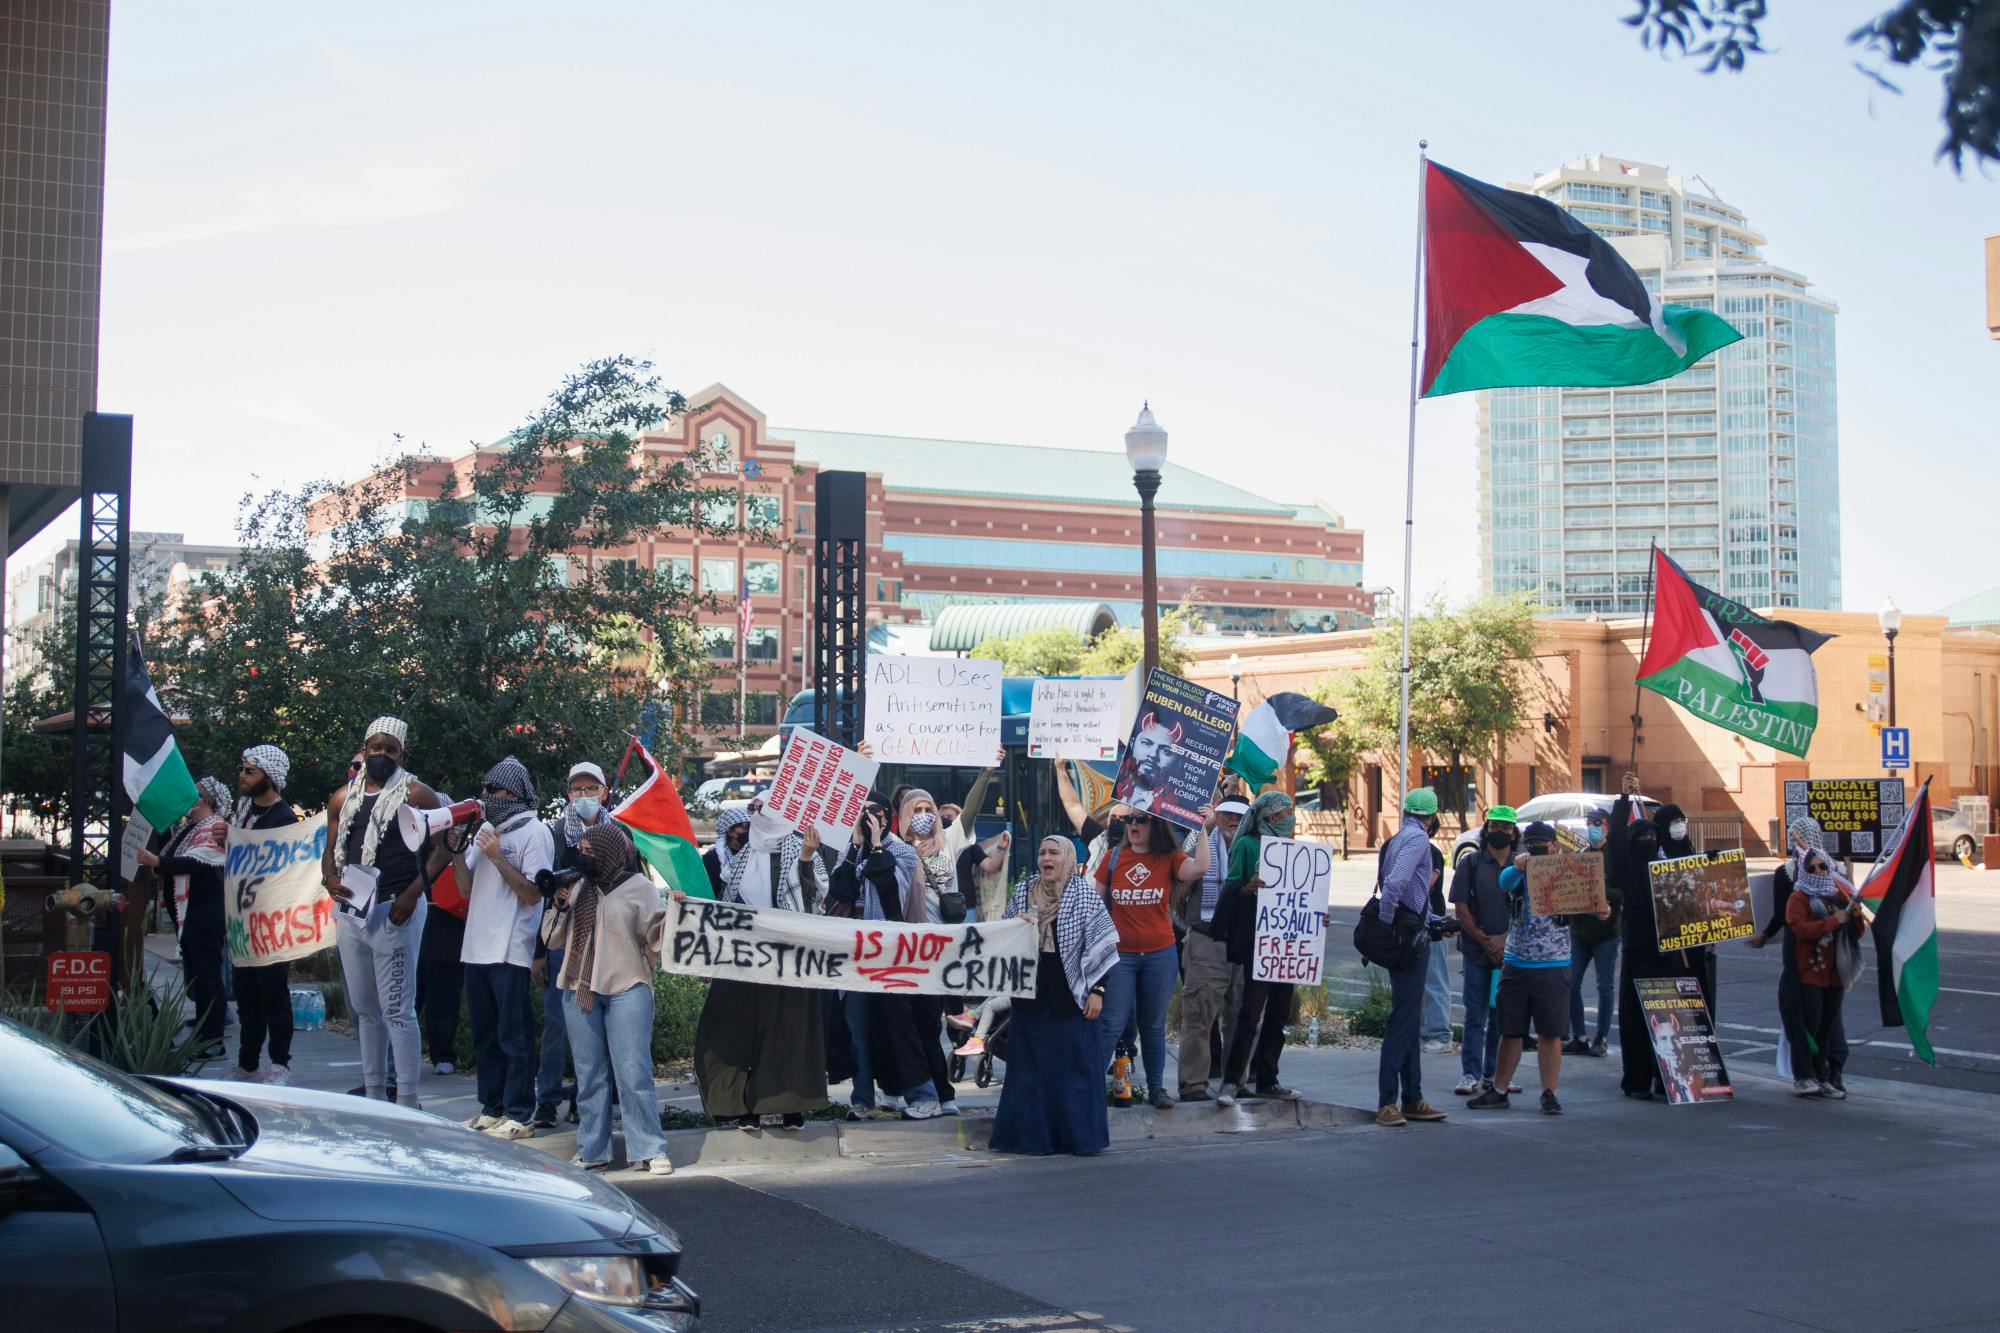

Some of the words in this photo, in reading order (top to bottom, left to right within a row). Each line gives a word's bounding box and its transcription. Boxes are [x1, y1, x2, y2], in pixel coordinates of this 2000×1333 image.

[874, 662, 923, 685] ADL
[938, 663, 993, 690] Uses
[1153, 672, 1175, 684] THERE
[1183, 682, 1205, 697] BLOOD
[1150, 679, 1160, 687] ON
[1161, 683, 1180, 695] YOUR
[1180, 689, 1203, 704] HANDS
[887, 692, 993, 714] Antisemitism
[1146, 691, 1183, 713] RUBEN
[1183, 705, 1232, 732] GALLEGO
[1216, 703, 1235, 714] AIPAC
[1218, 697, 1238, 709] TRACK
[875, 722, 895, 733] as
[810, 741, 826, 755] TO
[1184, 737, 1220, 757] RECEIVED
[1886, 731, 1905, 756] H
[768, 762, 797, 811] OCCUPIERS
[787, 735, 807, 764] DON'T
[799, 753, 820, 782] RIGHT
[811, 744, 845, 800] THEMSELVES
[1183, 762, 1207, 777] FROM
[1184, 772, 1200, 784] THE
[792, 779, 810, 798] THE
[1168, 776, 1210, 799] PRO-ISRAEL
[1174, 788, 1200, 803] LOBBY
[1807, 790, 1878, 800] YOURSELF
[1812, 780, 1876, 790] EDUCATE
[821, 786, 847, 826] AGAINST
[836, 768, 854, 788] THE
[841, 783, 869, 828] OCCUPIED
[1810, 802, 1826, 810] on
[1829, 801, 1878, 810] WHERE
[783, 797, 803, 822] HAVE
[1161, 802, 1205, 823] @TRACKAIPAC
[1812, 811, 1850, 821] YOUR
[1854, 810, 1878, 822] $$$
[1824, 821, 1862, 831] GOES
[1263, 842, 1331, 893] STOP
[1651, 861, 1676, 875] ONE
[237, 877, 265, 914] IS
[1112, 888, 1164, 900] GREEN
[1275, 891, 1309, 908] THE
[677, 902, 757, 933] FREE
[1256, 905, 1326, 937] ASSAULT
[1680, 921, 1709, 936] DOES
[1711, 916, 1732, 930] NOT
[1258, 935, 1313, 956] FREE
[1283, 932, 1298, 940] ON
[1660, 934, 1704, 950] JUSTIFY
[1706, 924, 1753, 943] ANOTHER
[672, 931, 849, 978] PALESTINE
[853, 930, 884, 961] IS
[892, 932, 954, 966] NOT
[959, 925, 985, 959] A
[52, 959, 107, 975] F.D.C.
[942, 956, 1036, 992] CRIME
[1257, 956, 1319, 983] SPEECH
[61, 986, 74, 995] 191
[78, 986, 97, 995] PSI
[1643, 999, 1666, 1010] GREG
[1667, 998, 1704, 1009] STANTON
